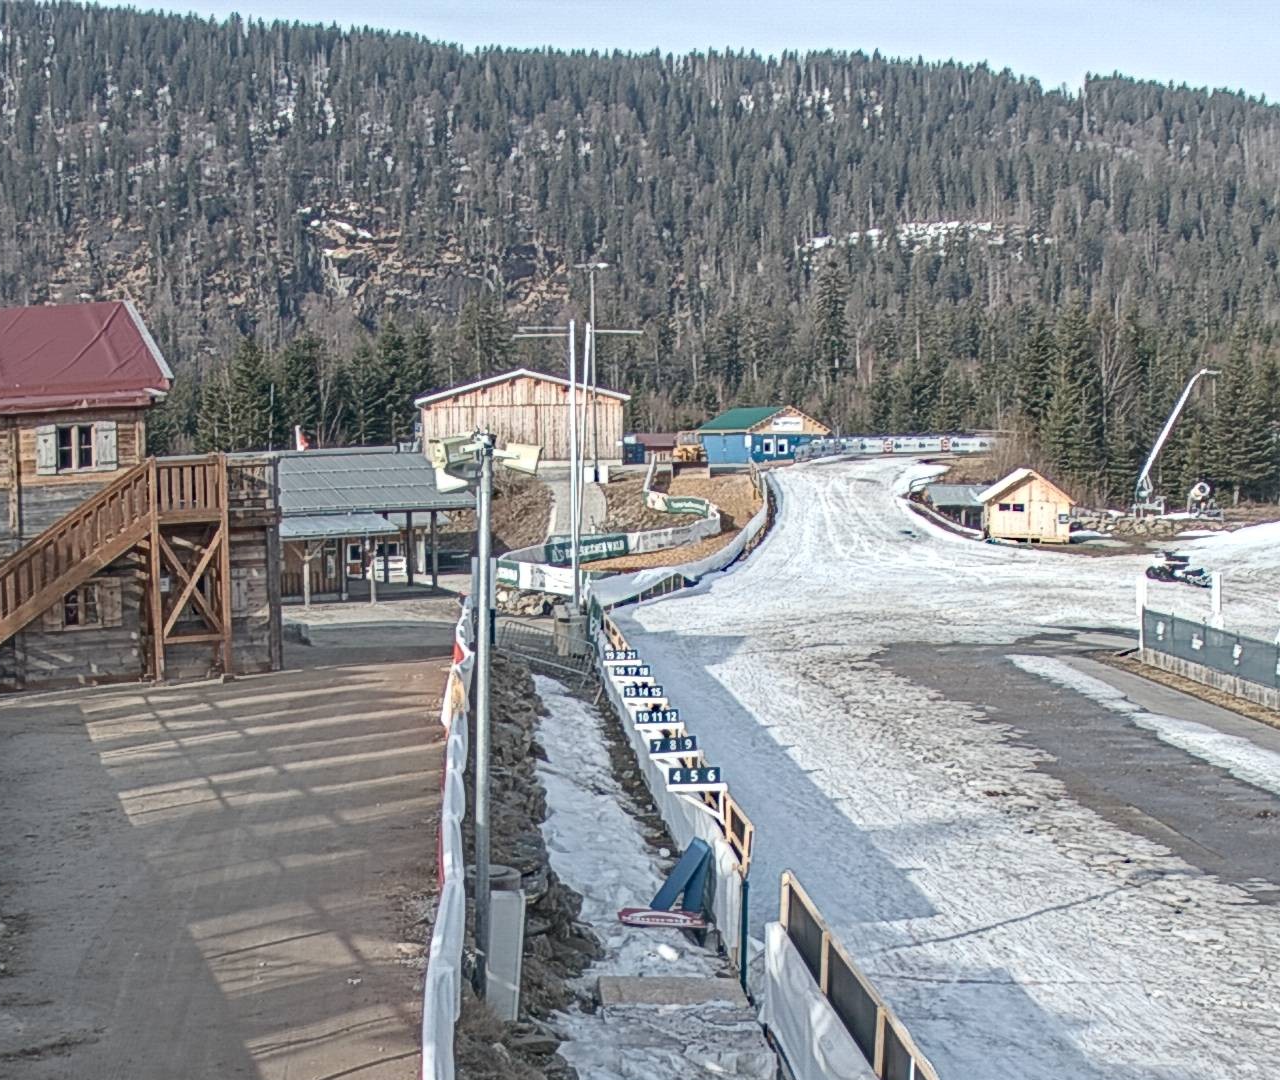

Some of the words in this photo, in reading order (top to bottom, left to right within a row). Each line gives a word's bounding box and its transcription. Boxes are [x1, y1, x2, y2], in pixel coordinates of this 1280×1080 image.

[627, 651, 636, 660] 21
[628, 667, 637, 675] 17
[626, 687, 636, 697] 13
[639, 687, 649, 697] 14
[651, 687, 661, 697] 15
[638, 712, 649, 722] 10
[652, 712, 663, 722] 11
[666, 711, 677, 722] 12
[654, 740, 661, 752] 7
[669, 739, 677, 751] 8
[684, 738, 693, 750] 9
[673, 770, 681, 782] 4
[690, 770, 698, 782] 5
[707, 769, 716, 782] 6
